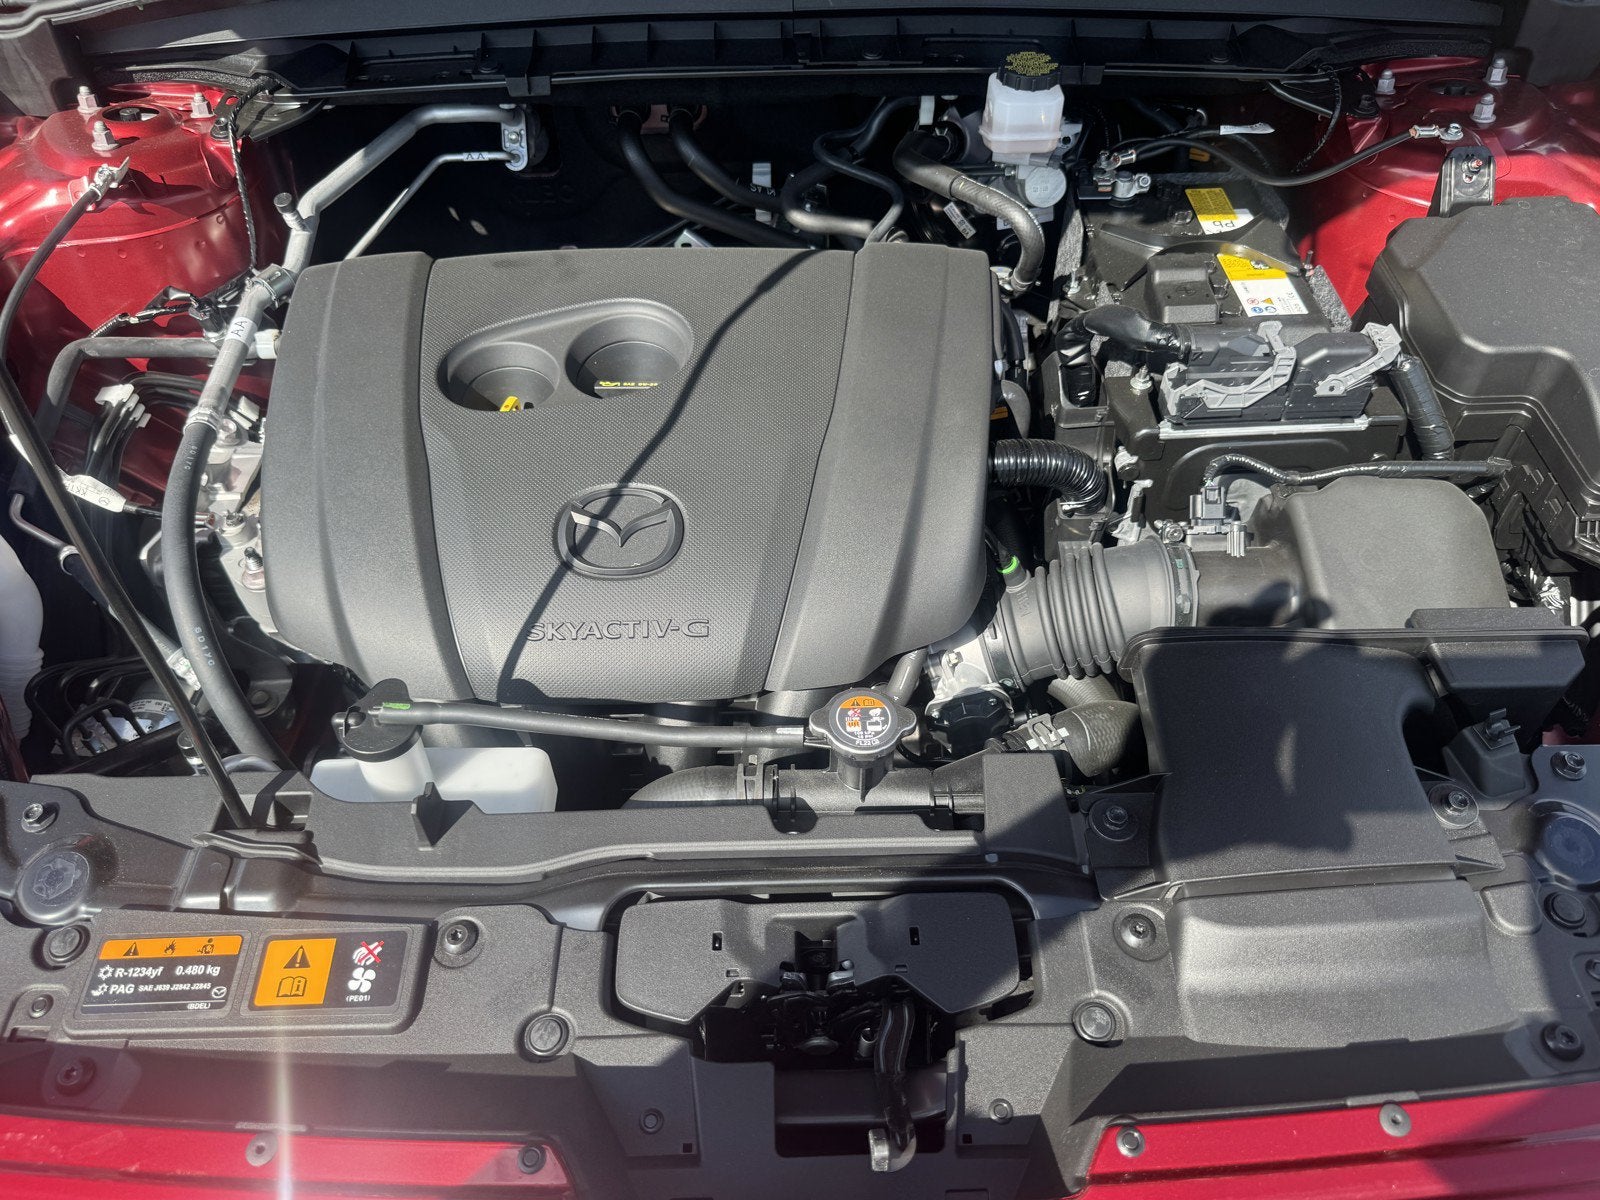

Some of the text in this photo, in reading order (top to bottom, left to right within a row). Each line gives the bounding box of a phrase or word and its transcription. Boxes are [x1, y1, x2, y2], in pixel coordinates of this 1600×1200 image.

[1212, 220, 1235, 228] Pb
[526, 618, 711, 642] SKYACTIV-G
[114, 964, 221, 979] R-1234yf 0.480 kg
[109, 984, 136, 995] PAG
[138, 984, 154, 992] SAE
[171, 983, 191, 991] J2842
[191, 982, 212, 990] J2845
